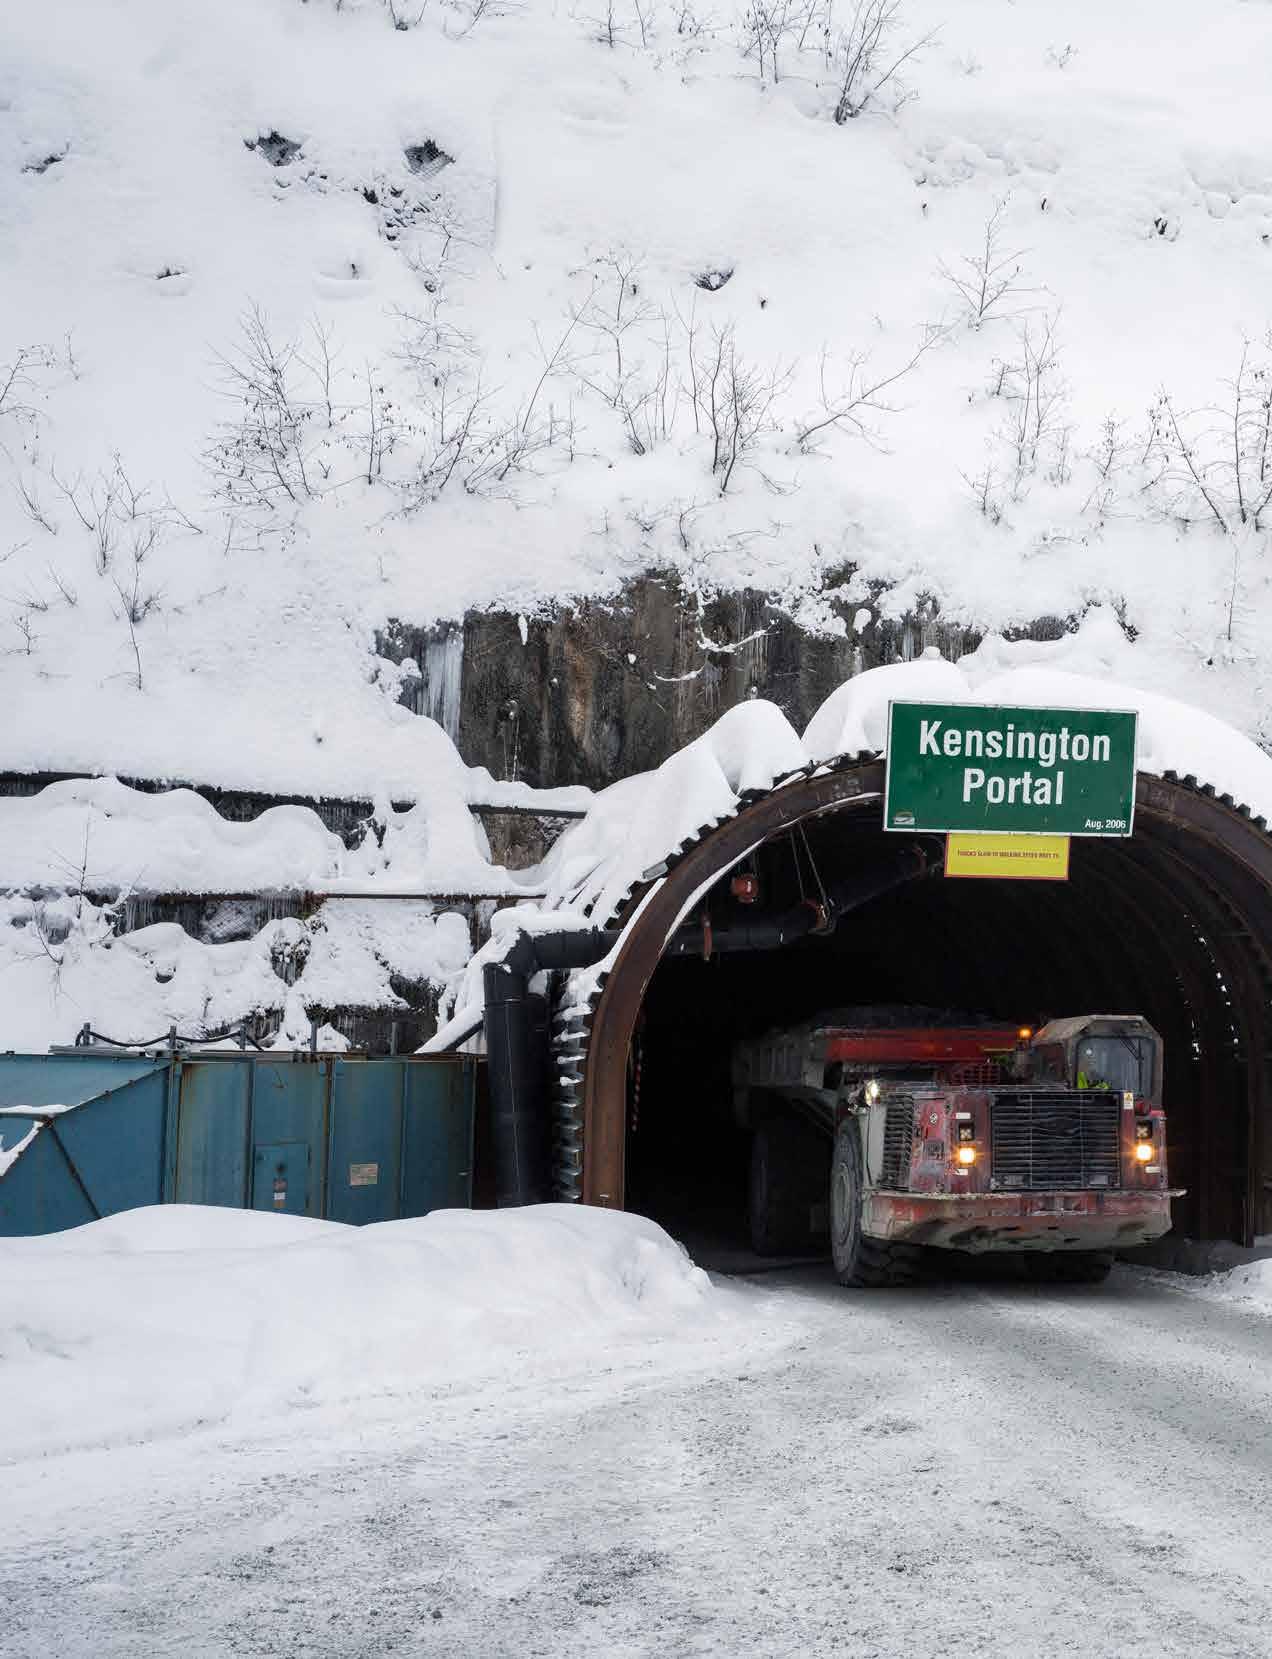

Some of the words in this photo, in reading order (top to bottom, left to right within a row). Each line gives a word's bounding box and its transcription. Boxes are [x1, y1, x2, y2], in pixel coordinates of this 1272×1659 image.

[919, 720, 1111, 768] Kensington
[963, 768, 1064, 805] Portal
[1084, 818, 1104, 830] Aug.
[1105, 819, 1126, 829] 2006
